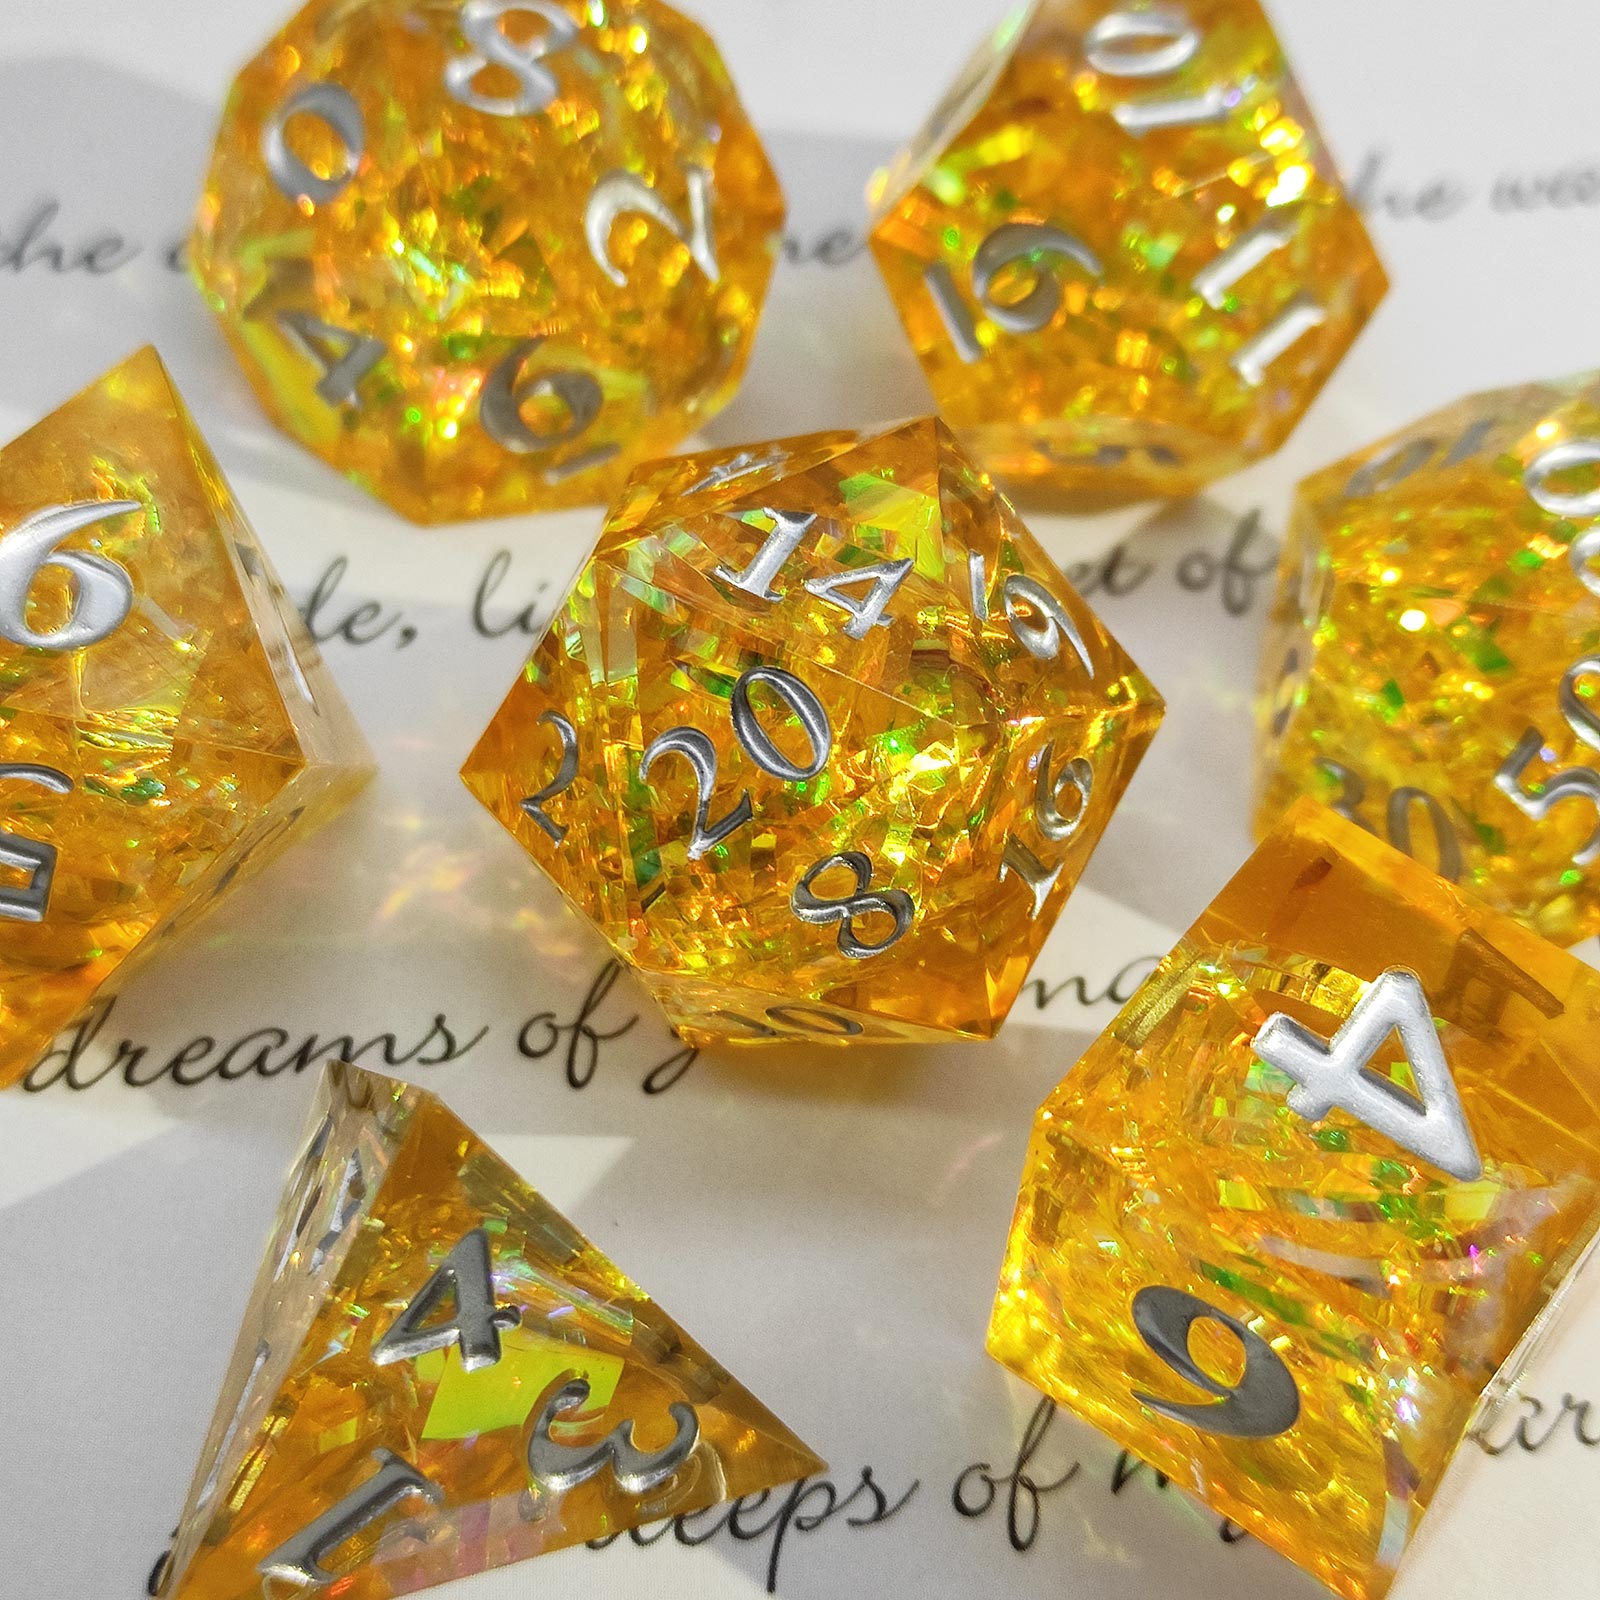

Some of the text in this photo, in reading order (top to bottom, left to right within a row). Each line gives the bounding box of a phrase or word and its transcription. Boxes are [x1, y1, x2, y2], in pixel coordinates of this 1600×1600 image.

[446, 0, 577, 116] 8
[585, 168, 721, 287] 2
[0, 496, 142, 651] 6
[714, 506, 914, 638] 14
[520, 711, 578, 848] 2
[628, 666, 833, 860] 20
[790, 850, 916, 959] 8
[22, 992, 489, 1093] dreams
[517, 960, 642, 1091] of
[1250, 967, 1482, 1182] 4
[370, 1228, 522, 1373] 4
[525, 1368, 701, 1494] 3
[952, 1394, 1081, 1551] of
[256, 1448, 445, 1586] 1
